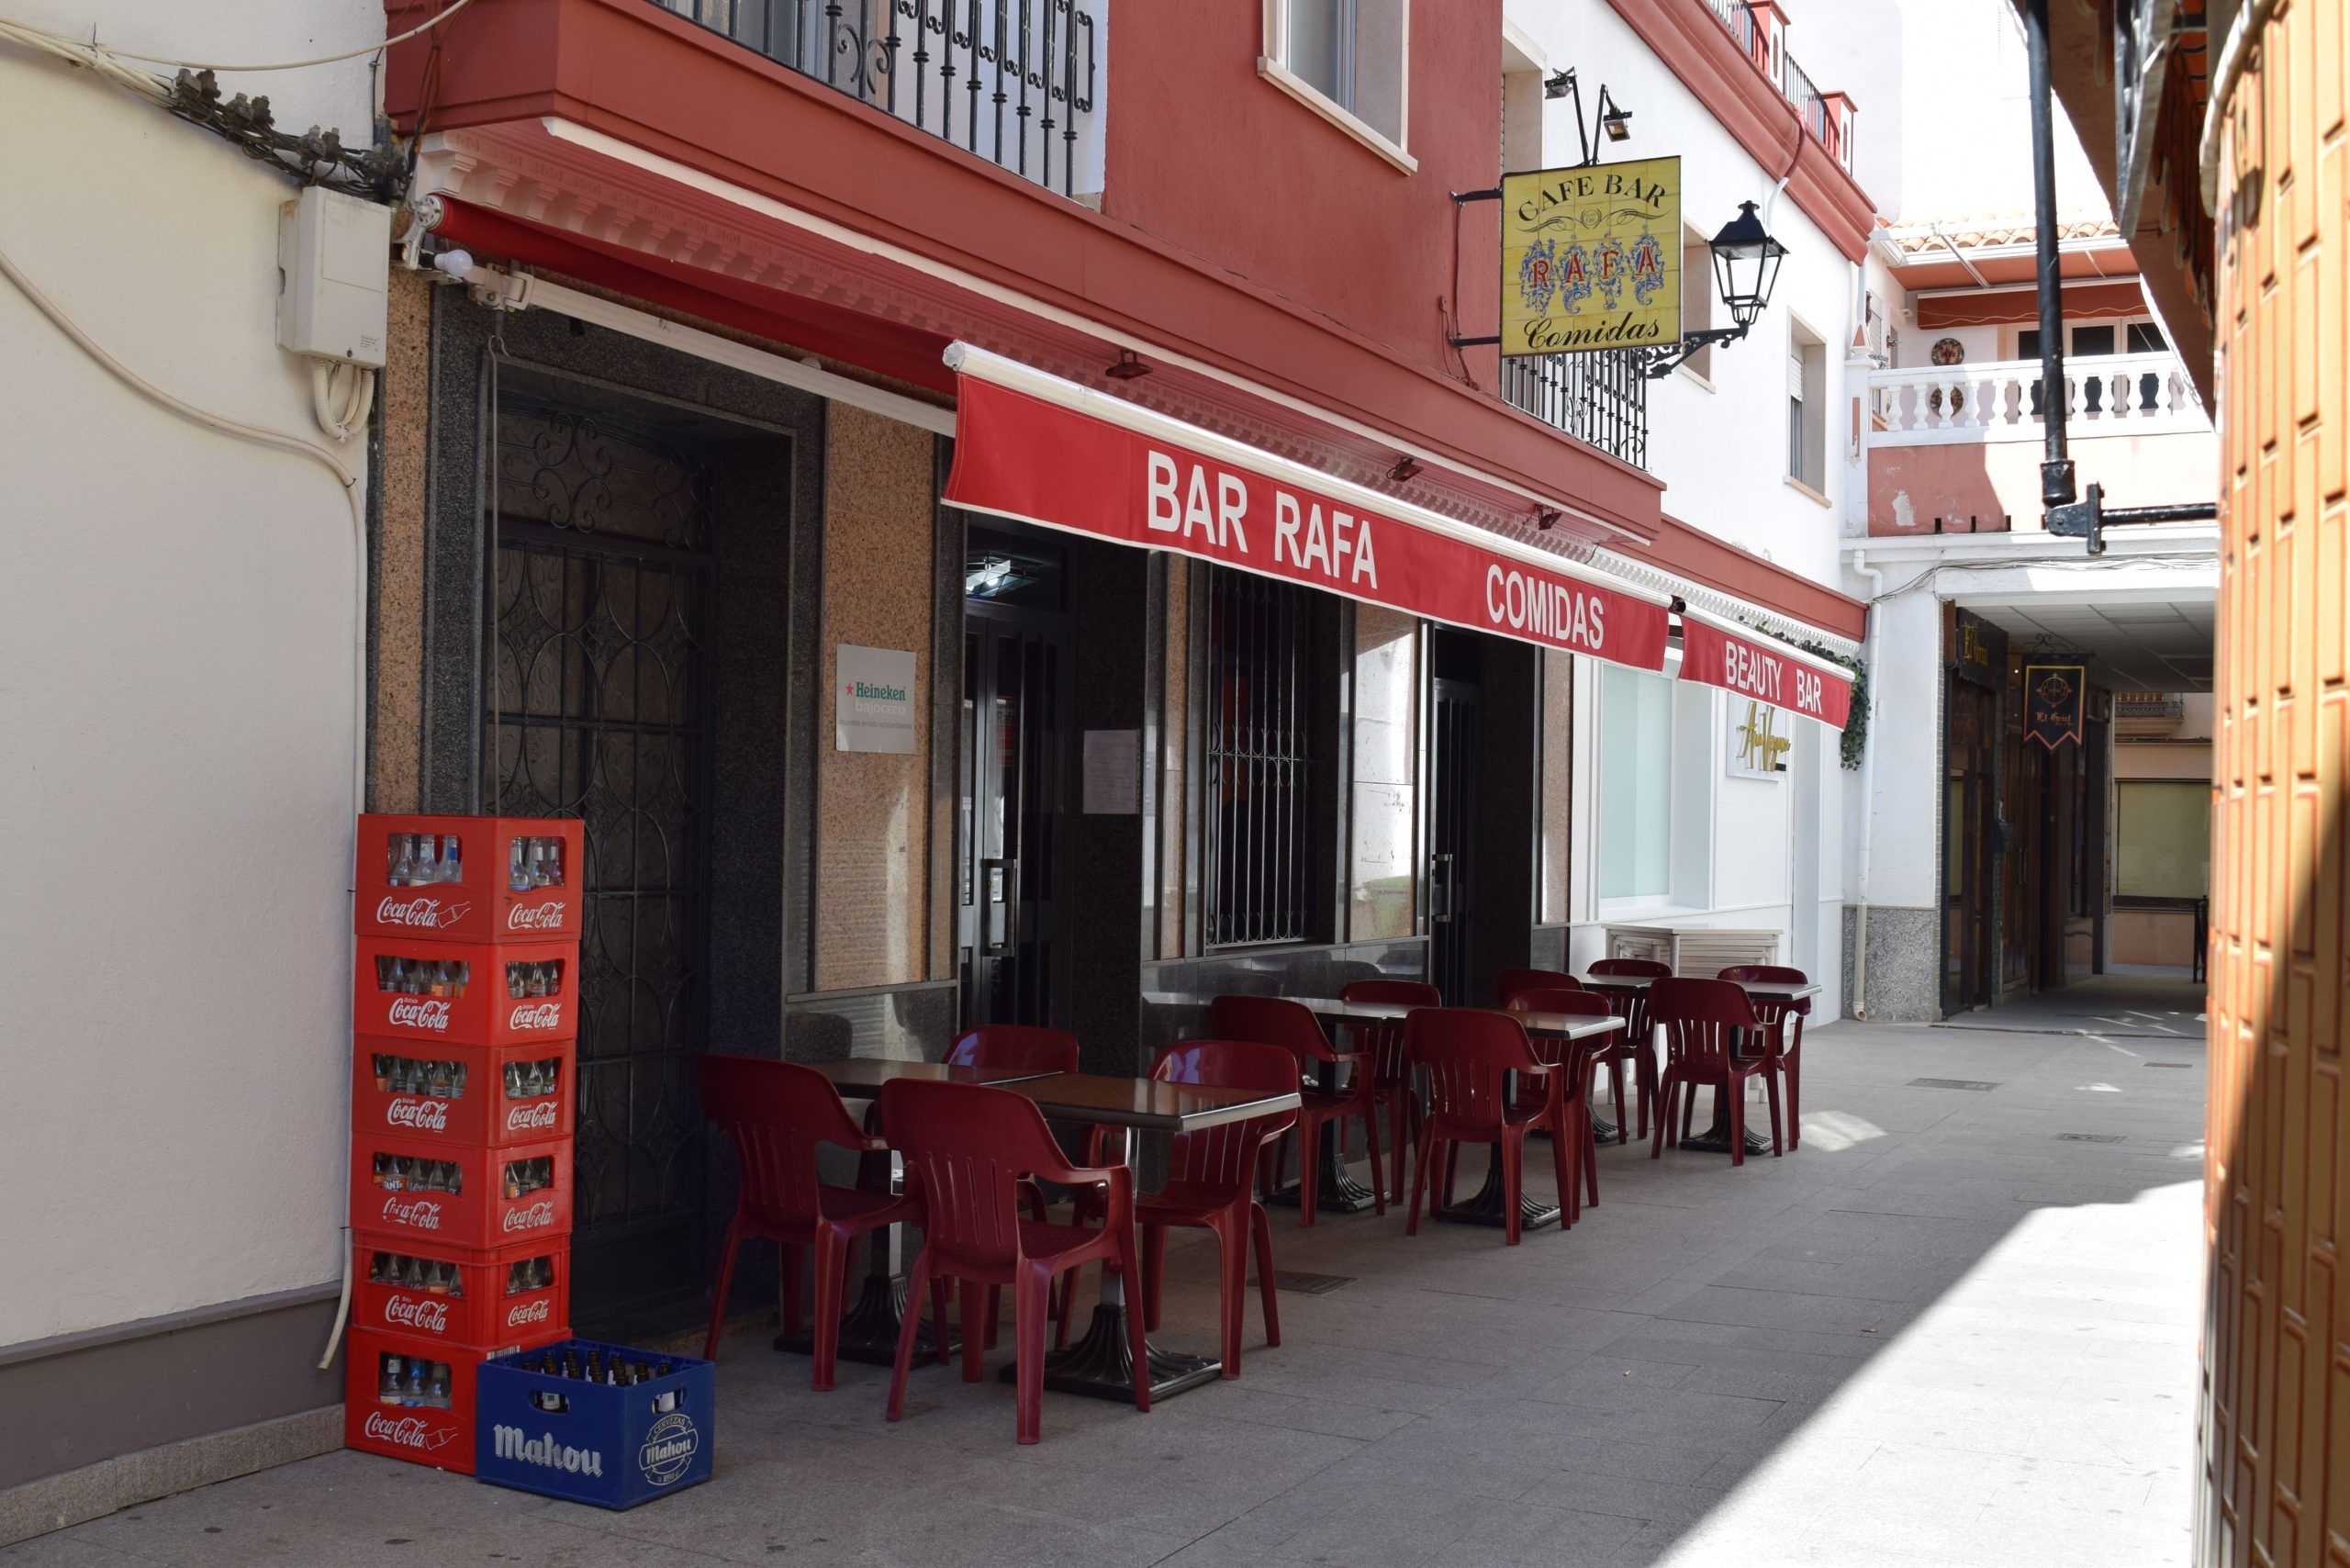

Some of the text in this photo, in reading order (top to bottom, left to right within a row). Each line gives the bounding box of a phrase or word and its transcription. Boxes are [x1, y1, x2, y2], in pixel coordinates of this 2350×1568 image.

[1517, 174, 1667, 223] CAFE BAR
[1531, 245, 1657, 288] RAFA
[1523, 311, 1660, 351] Comidas
[1147, 450, 1377, 589] BAR RAFA
[1486, 564, 1605, 651] COMIDAS
[856, 681, 906, 701] Heineken
[1725, 640, 1823, 716] BEAUTY BAR
[856, 700, 906, 716] bajocero
[376, 896, 441, 927] Coca-Cola
[508, 902, 566, 930] Coca-Cola
[388, 997, 451, 1029] Coca-Cola
[509, 1002, 561, 1030] Coca-Cola
[386, 1097, 448, 1130] Coca-Cola
[508, 1101, 558, 1130] Coca-Cola
[503, 1201, 554, 1232] Coca-Cola
[385, 1294, 449, 1331] Coca-Cola
[508, 1299, 551, 1327] Coca-Cola
[364, 1411, 429, 1448] Coca-Cola
[653, 1417, 687, 1434] CERVEZAS
[493, 1424, 603, 1478] Mahou
[646, 1438, 691, 1464] Mahou
